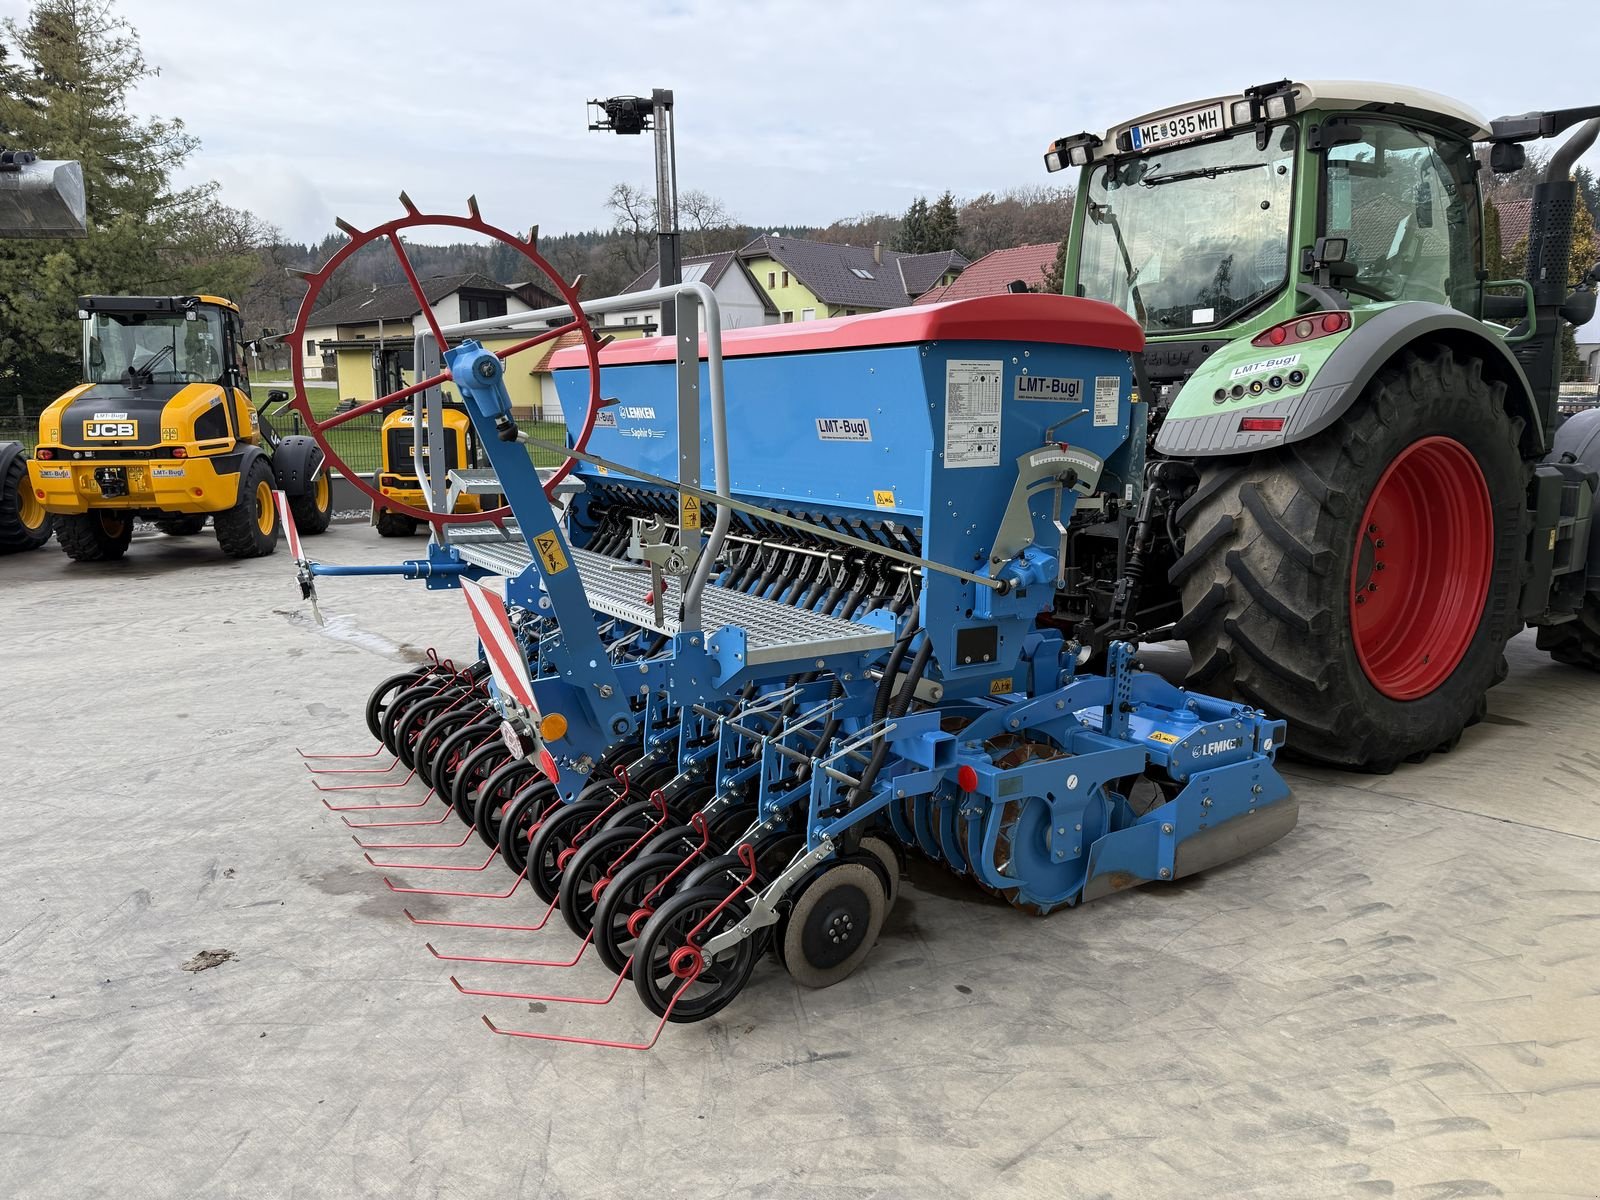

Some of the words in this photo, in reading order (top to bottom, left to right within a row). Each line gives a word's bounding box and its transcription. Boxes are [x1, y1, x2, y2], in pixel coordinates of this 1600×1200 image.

[1141, 125, 1160, 145] ME
[1169, 115, 1195, 137] 935
[1197, 109, 1218, 131] MH
[1234, 355, 1296, 376] LMT-Bugl
[1018, 377, 1080, 398] LMT-Bugl
[625, 407, 656, 420] LEMKEN
[87, 423, 134, 437] JCB
[630, 427, 647, 440] Saphir
[818, 419, 868, 437] LMT-Bugl
[153, 469, 184, 478] LMT-Bugl
[1202, 736, 1243, 756] LEMKEN
